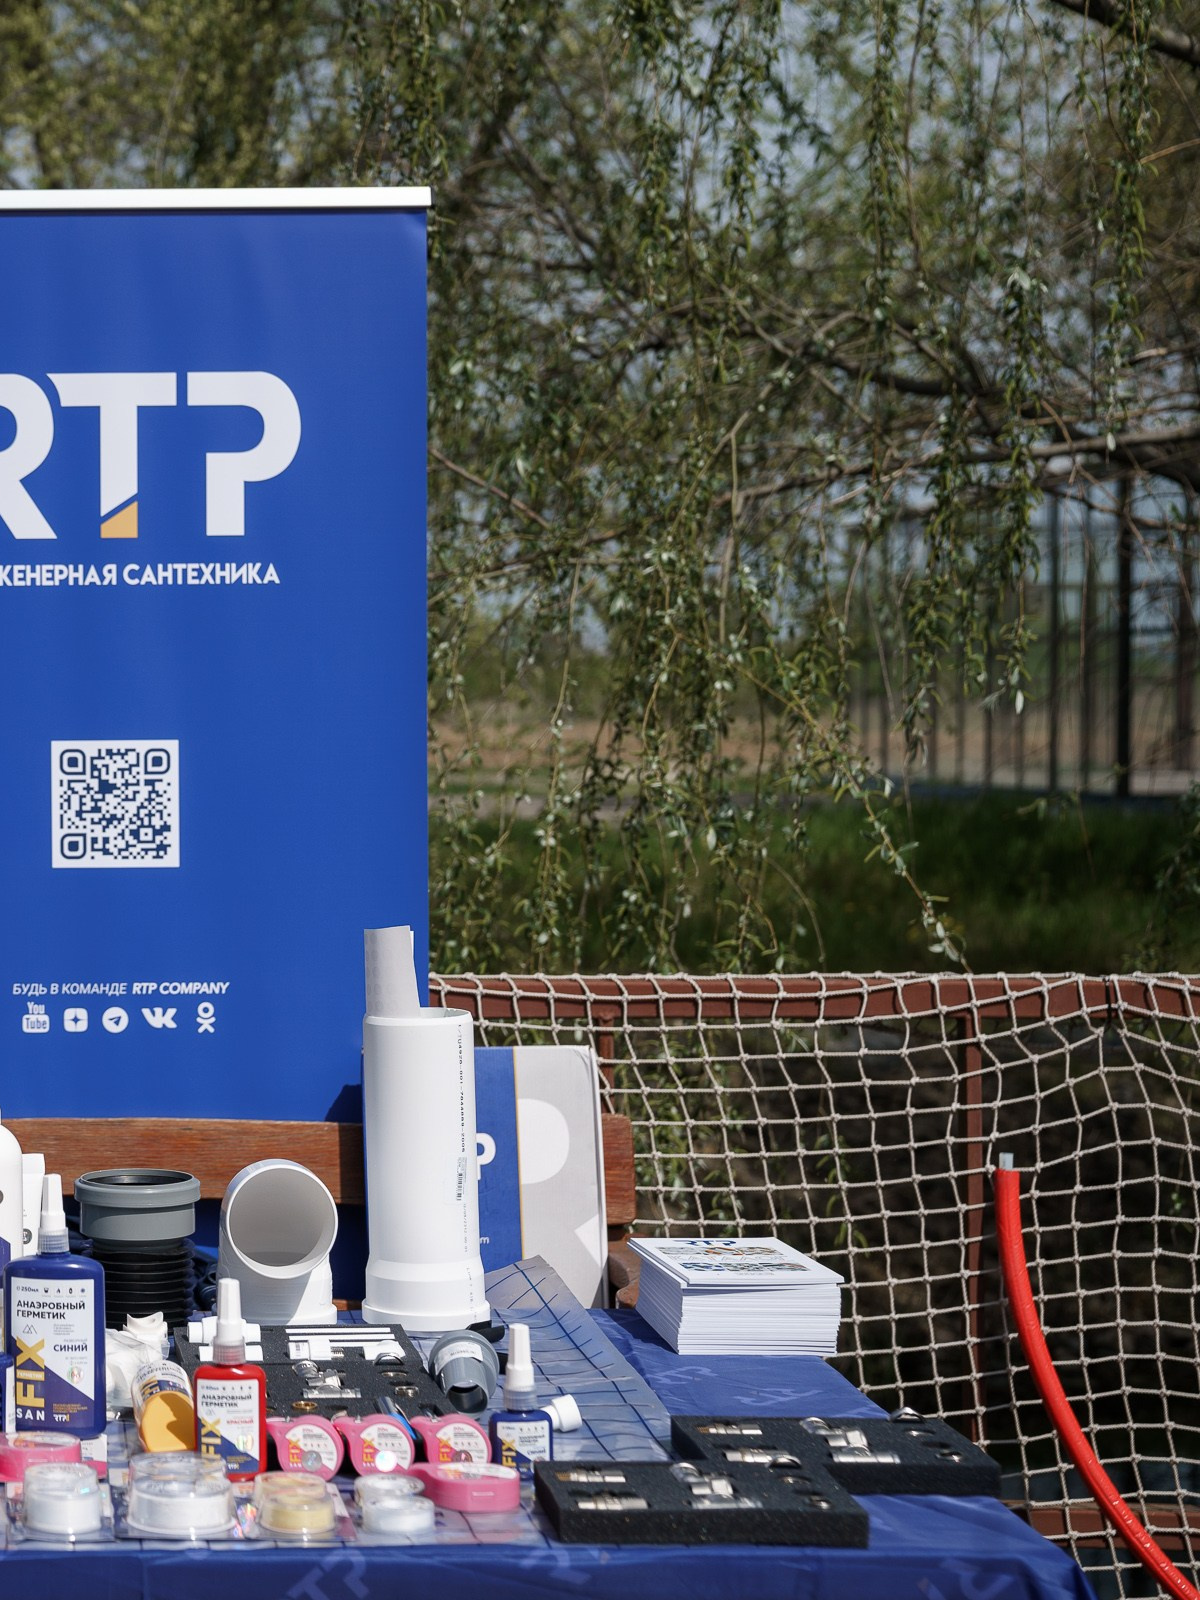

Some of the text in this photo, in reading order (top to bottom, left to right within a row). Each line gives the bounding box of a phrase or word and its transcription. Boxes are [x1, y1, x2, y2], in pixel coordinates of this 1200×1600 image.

[122, 563, 281, 585] САНТЕХНИКА
[12, 982, 230, 997] БУДЬ В КОМАНДЕ RTP COMPANY
[16, 1300, 86, 1310] АНАЭРОБНЫЙ
[16, 1309, 66, 1320] ГЕРМЕТИК
[53, 1343, 88, 1352] СИНИЙ
[16, 1337, 45, 1408] FIX
[16, 1408, 45, 1421] SAN
[289, 1439, 301, 1463] FIX
[363, 1439, 375, 1463] FIX
[502, 1439, 517, 1468] FIX
